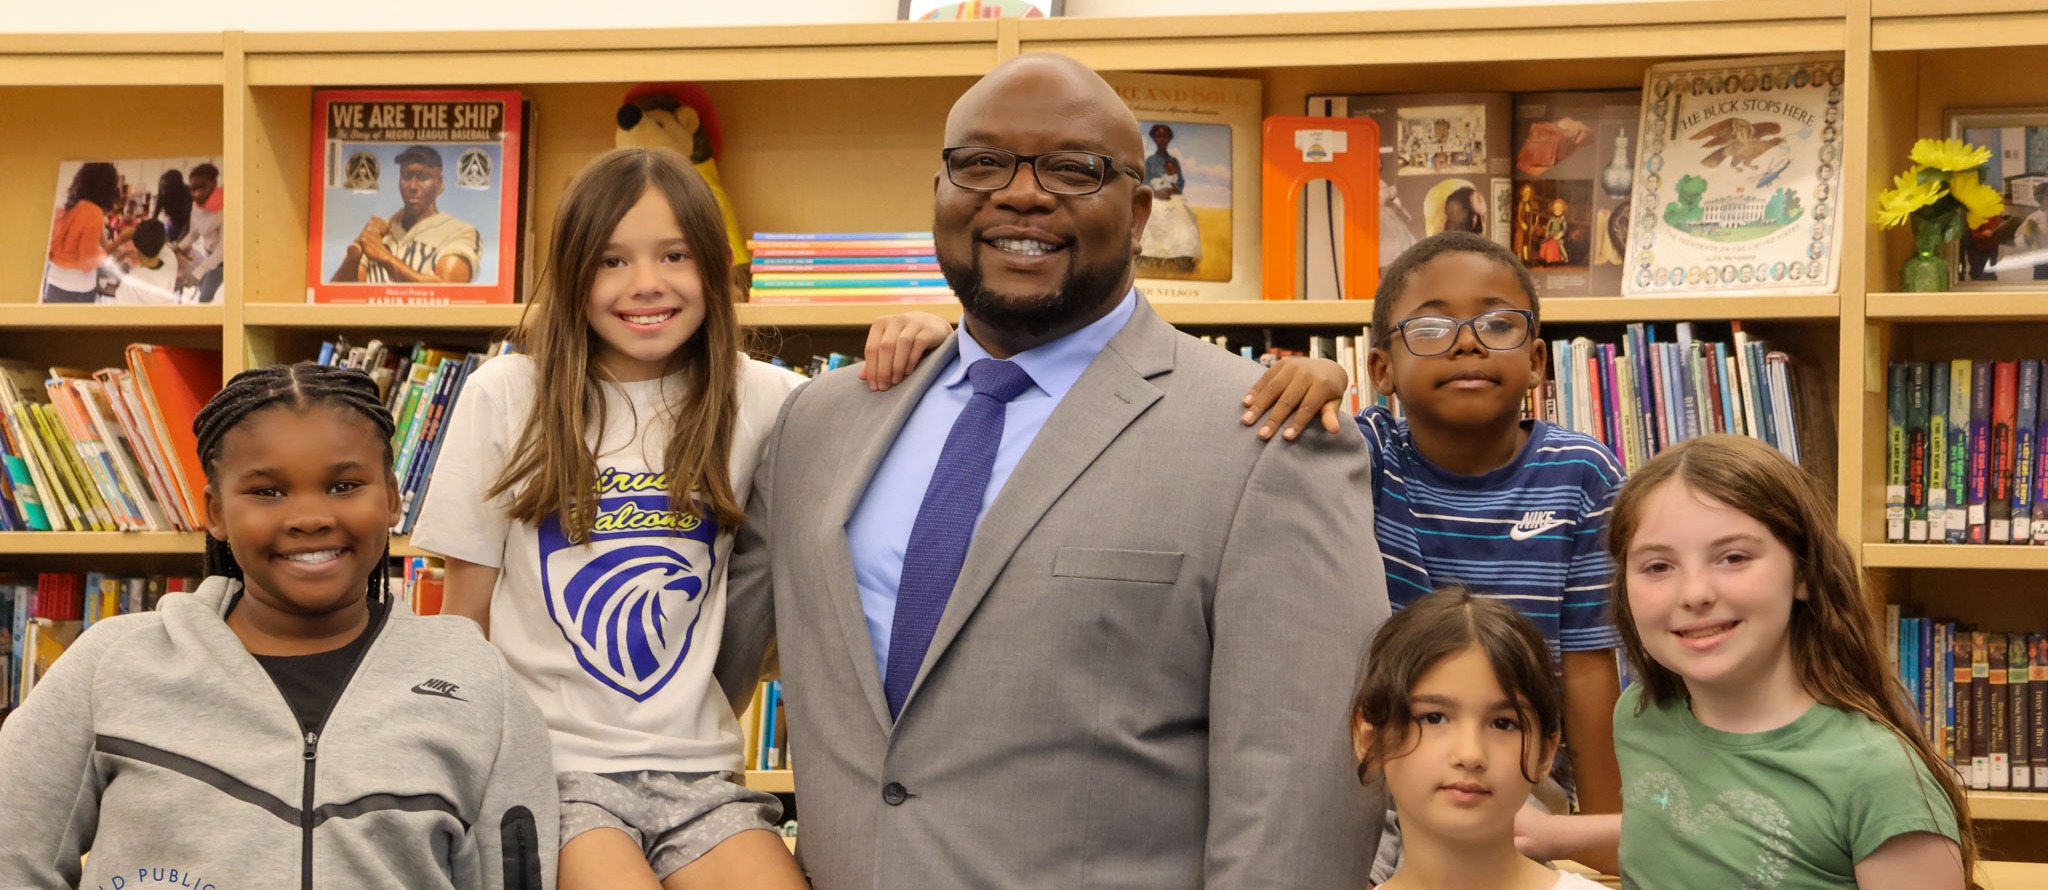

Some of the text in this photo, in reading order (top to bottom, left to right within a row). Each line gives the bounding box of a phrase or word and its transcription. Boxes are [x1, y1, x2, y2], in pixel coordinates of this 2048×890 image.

[1146, 87, 1187, 101] AND
[333, 104, 499, 129] WE ARE THE SHIP
[1680, 99, 1817, 130] HE BUCK STOPS HERE
[350, 129, 370, 141] Story
[385, 130, 414, 140] NEGRO
[417, 130, 448, 140] LEAGUE
[451, 130, 490, 140] BASEBALL
[1547, 401, 1555, 415] TEK
[1914, 442, 1923, 459] LAST
[1977, 436, 1985, 452] LAST
[1999, 437, 2007, 454] LAST
[2022, 442, 2030, 459] LAST
[1914, 459, 1922, 476] KIDS
[1956, 459, 1964, 476] KIDS
[1977, 453, 1985, 470] KIDS
[1998, 455, 2006, 471] KIDS
[2021, 459, 2029, 476] KIDS
[1914, 483, 1922, 505] EARTH
[1956, 483, 1964, 505] EARTH
[1977, 476, 1985, 498] EARTH
[1997, 478, 2006, 500] EARTH
[2019, 483, 2028, 505] EARTH
[576, 501, 702, 537] alcons
[1519, 511, 1557, 529] NIKE
[421, 678, 460, 697] NIKE
[2035, 690, 2044, 709] INTO
